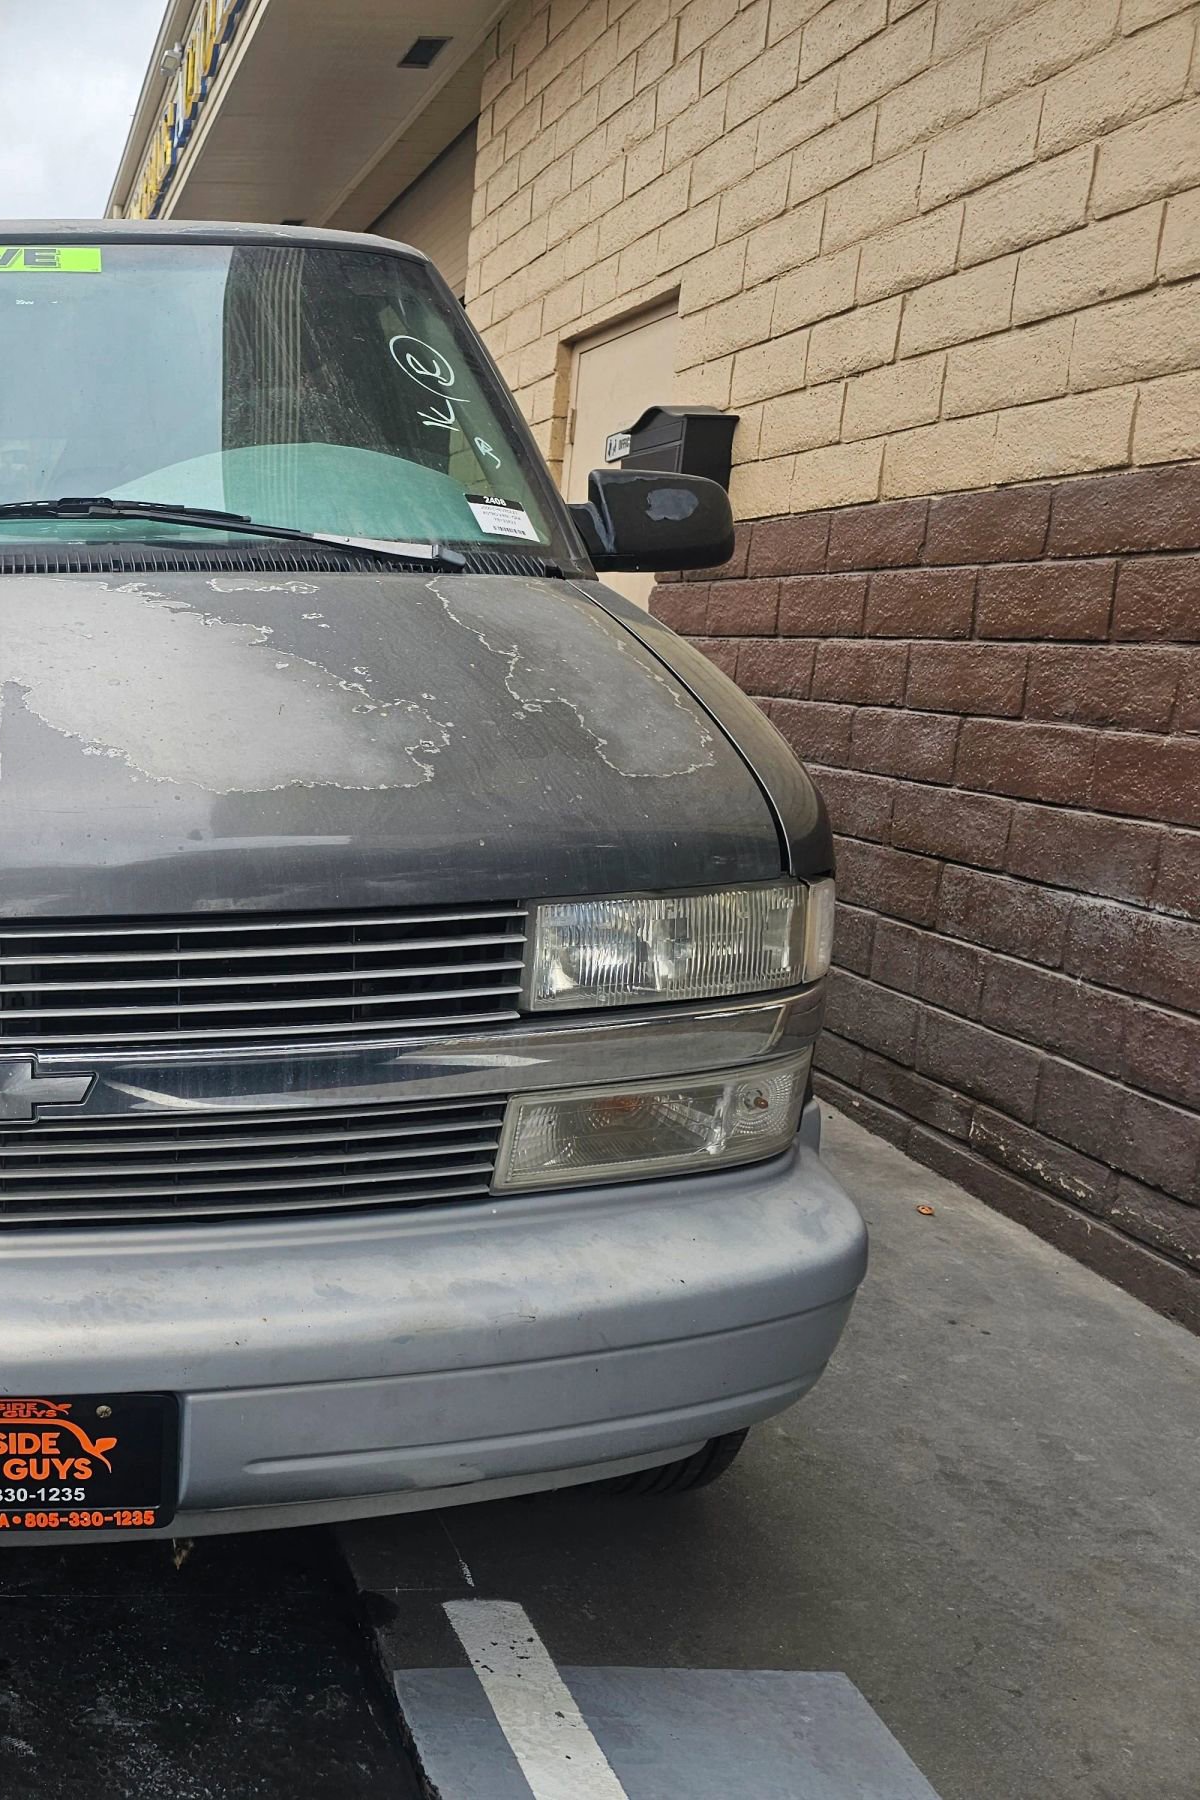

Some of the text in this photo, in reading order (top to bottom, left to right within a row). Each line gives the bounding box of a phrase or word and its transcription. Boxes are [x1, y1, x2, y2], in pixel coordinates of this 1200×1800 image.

[2, 1410, 57, 1418] GUYS
[3, 1458, 93, 1480] GUYS
[24, 1510, 156, 1528] 805-330-1235
